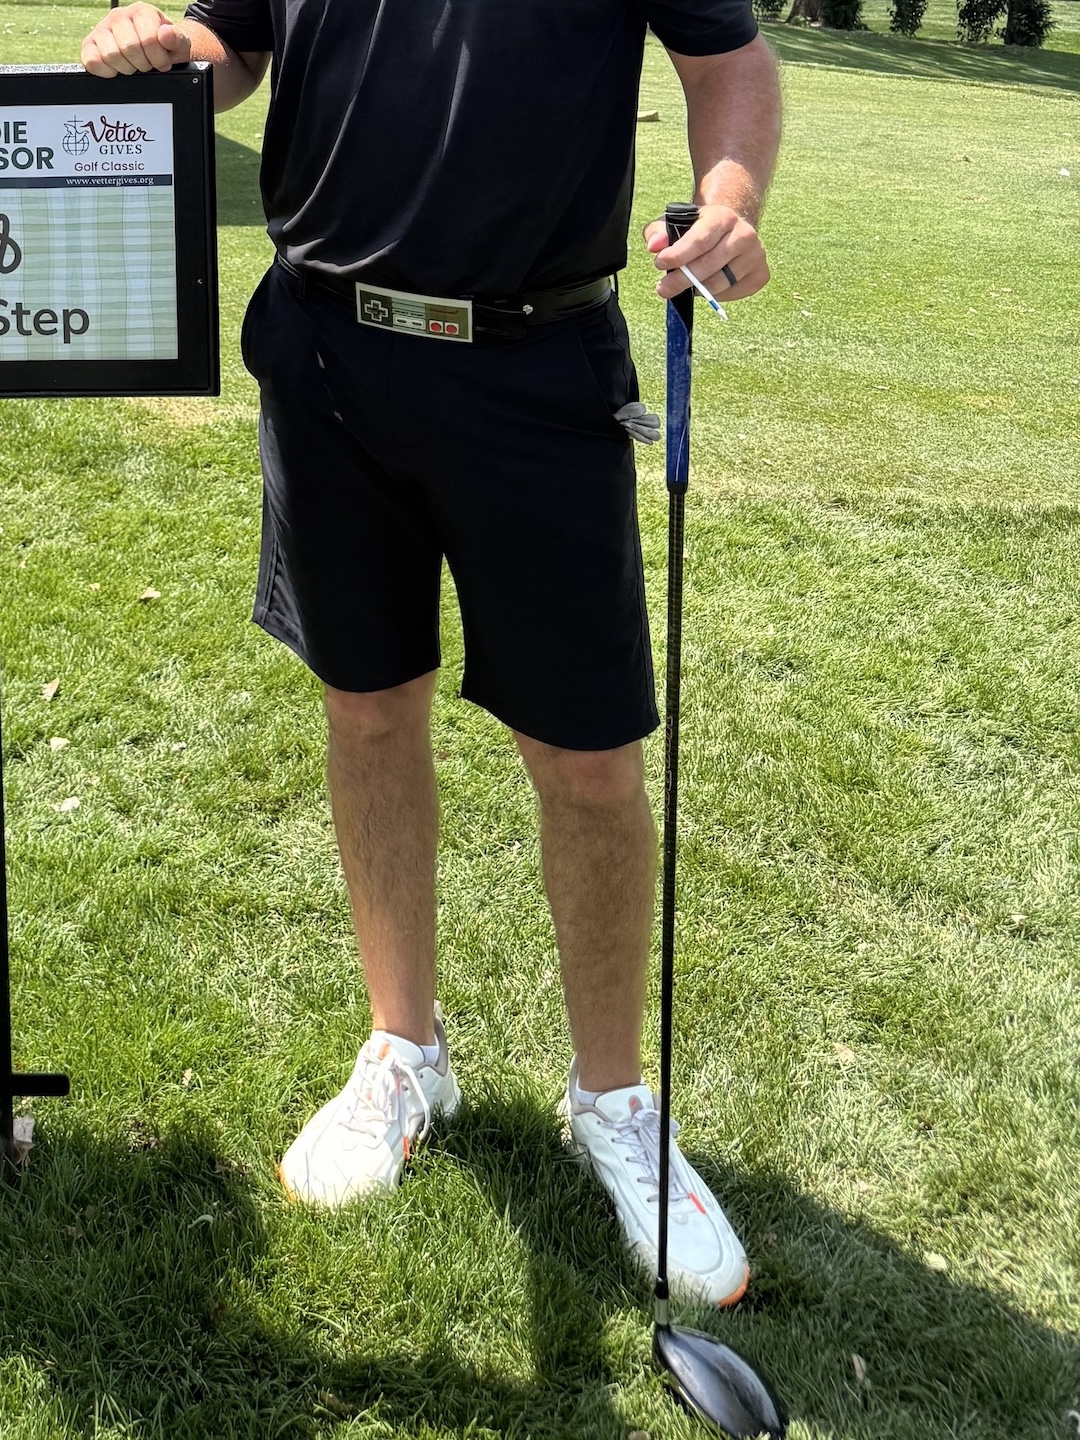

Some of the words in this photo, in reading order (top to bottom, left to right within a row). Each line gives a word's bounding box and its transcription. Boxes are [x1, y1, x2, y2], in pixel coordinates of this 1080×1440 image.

[80, 115, 156, 143] Vetter
[99, 144, 143, 155] GIVES
[74, 161, 98, 172] Golf
[101, 160, 145, 171] Classic
[65, 176, 154, 186] www.vettergives.org
